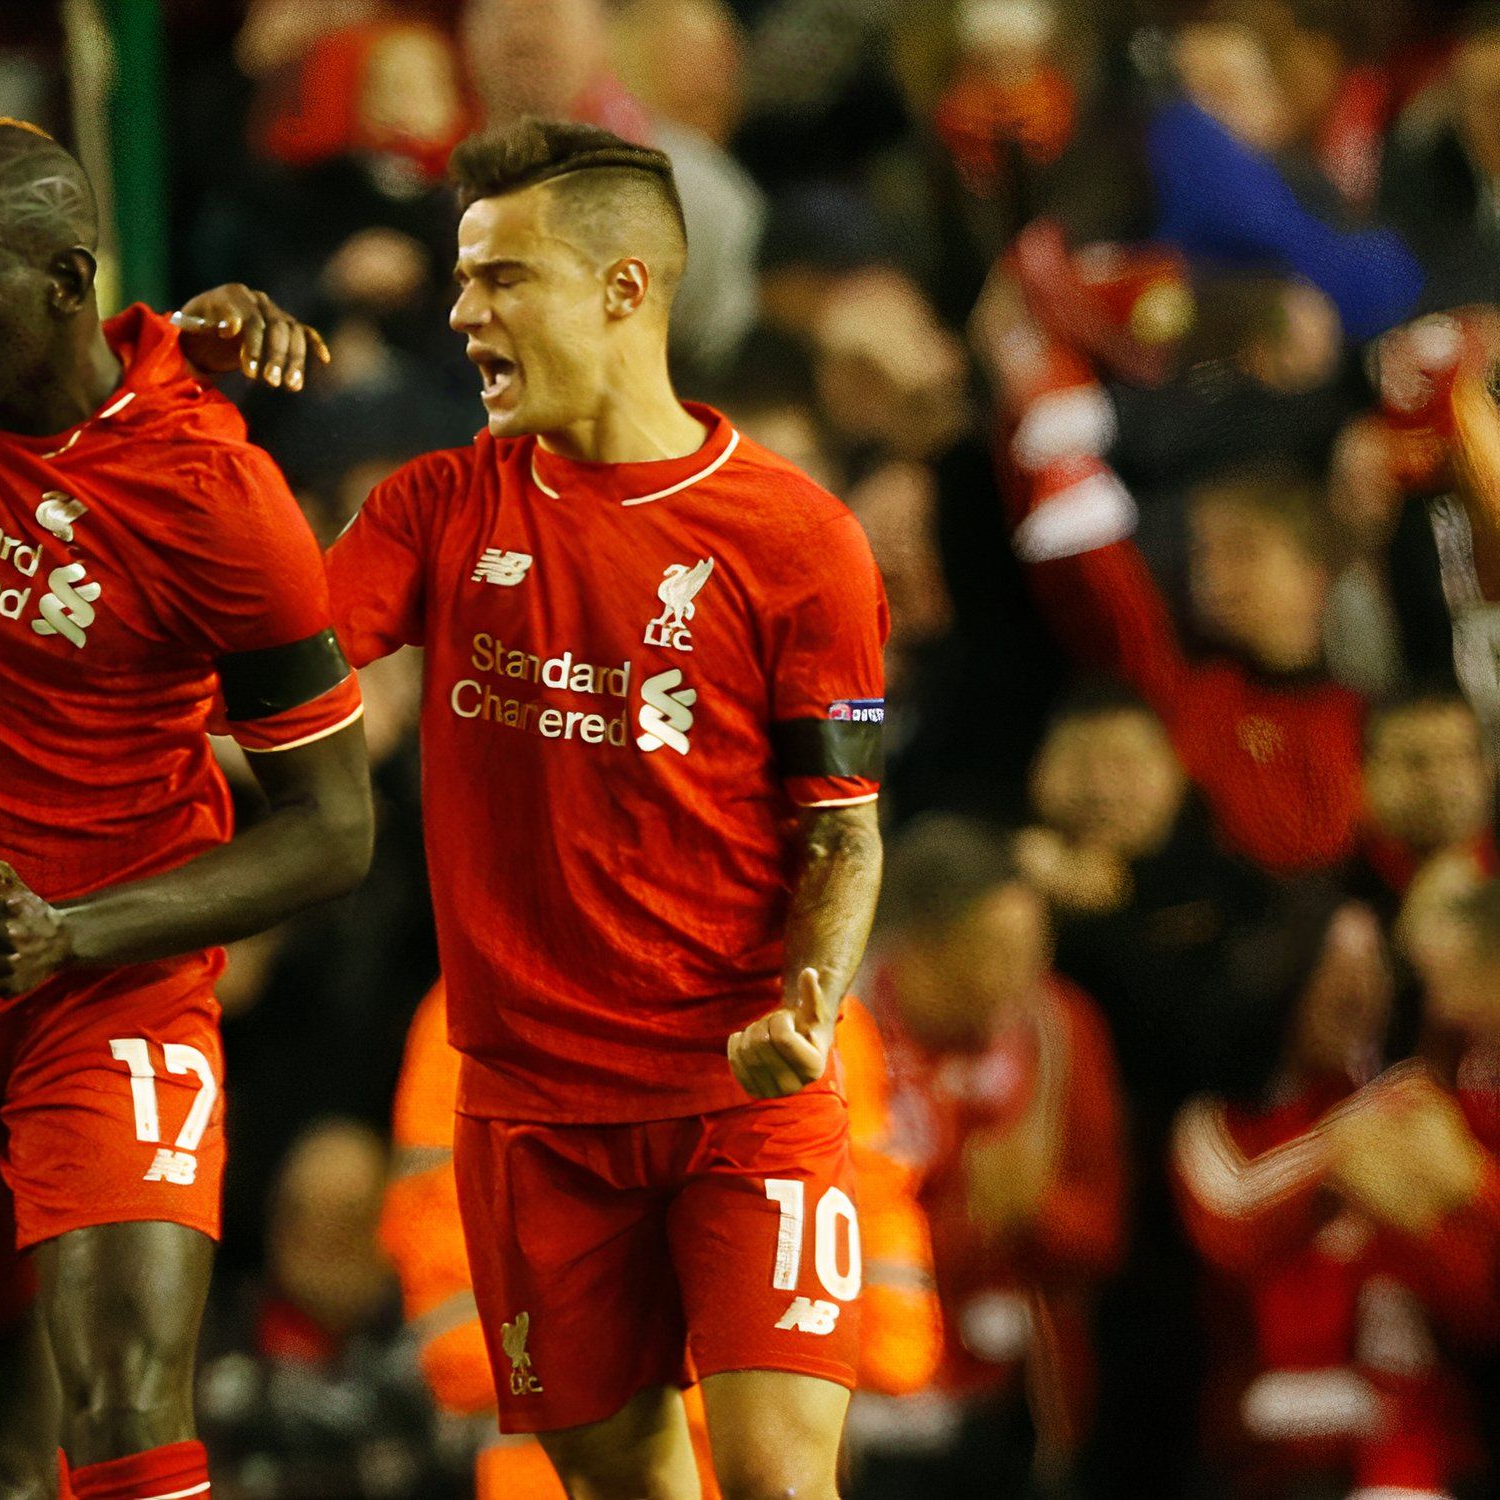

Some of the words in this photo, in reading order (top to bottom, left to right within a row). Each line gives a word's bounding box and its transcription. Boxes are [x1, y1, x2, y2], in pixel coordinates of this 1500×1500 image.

[470, 547, 534, 587] NB
[471, 632, 632, 698] Standard
[643, 617, 694, 652] LFC
[108, 1037, 219, 1151] 17
[764, 1178, 863, 1302] 10
